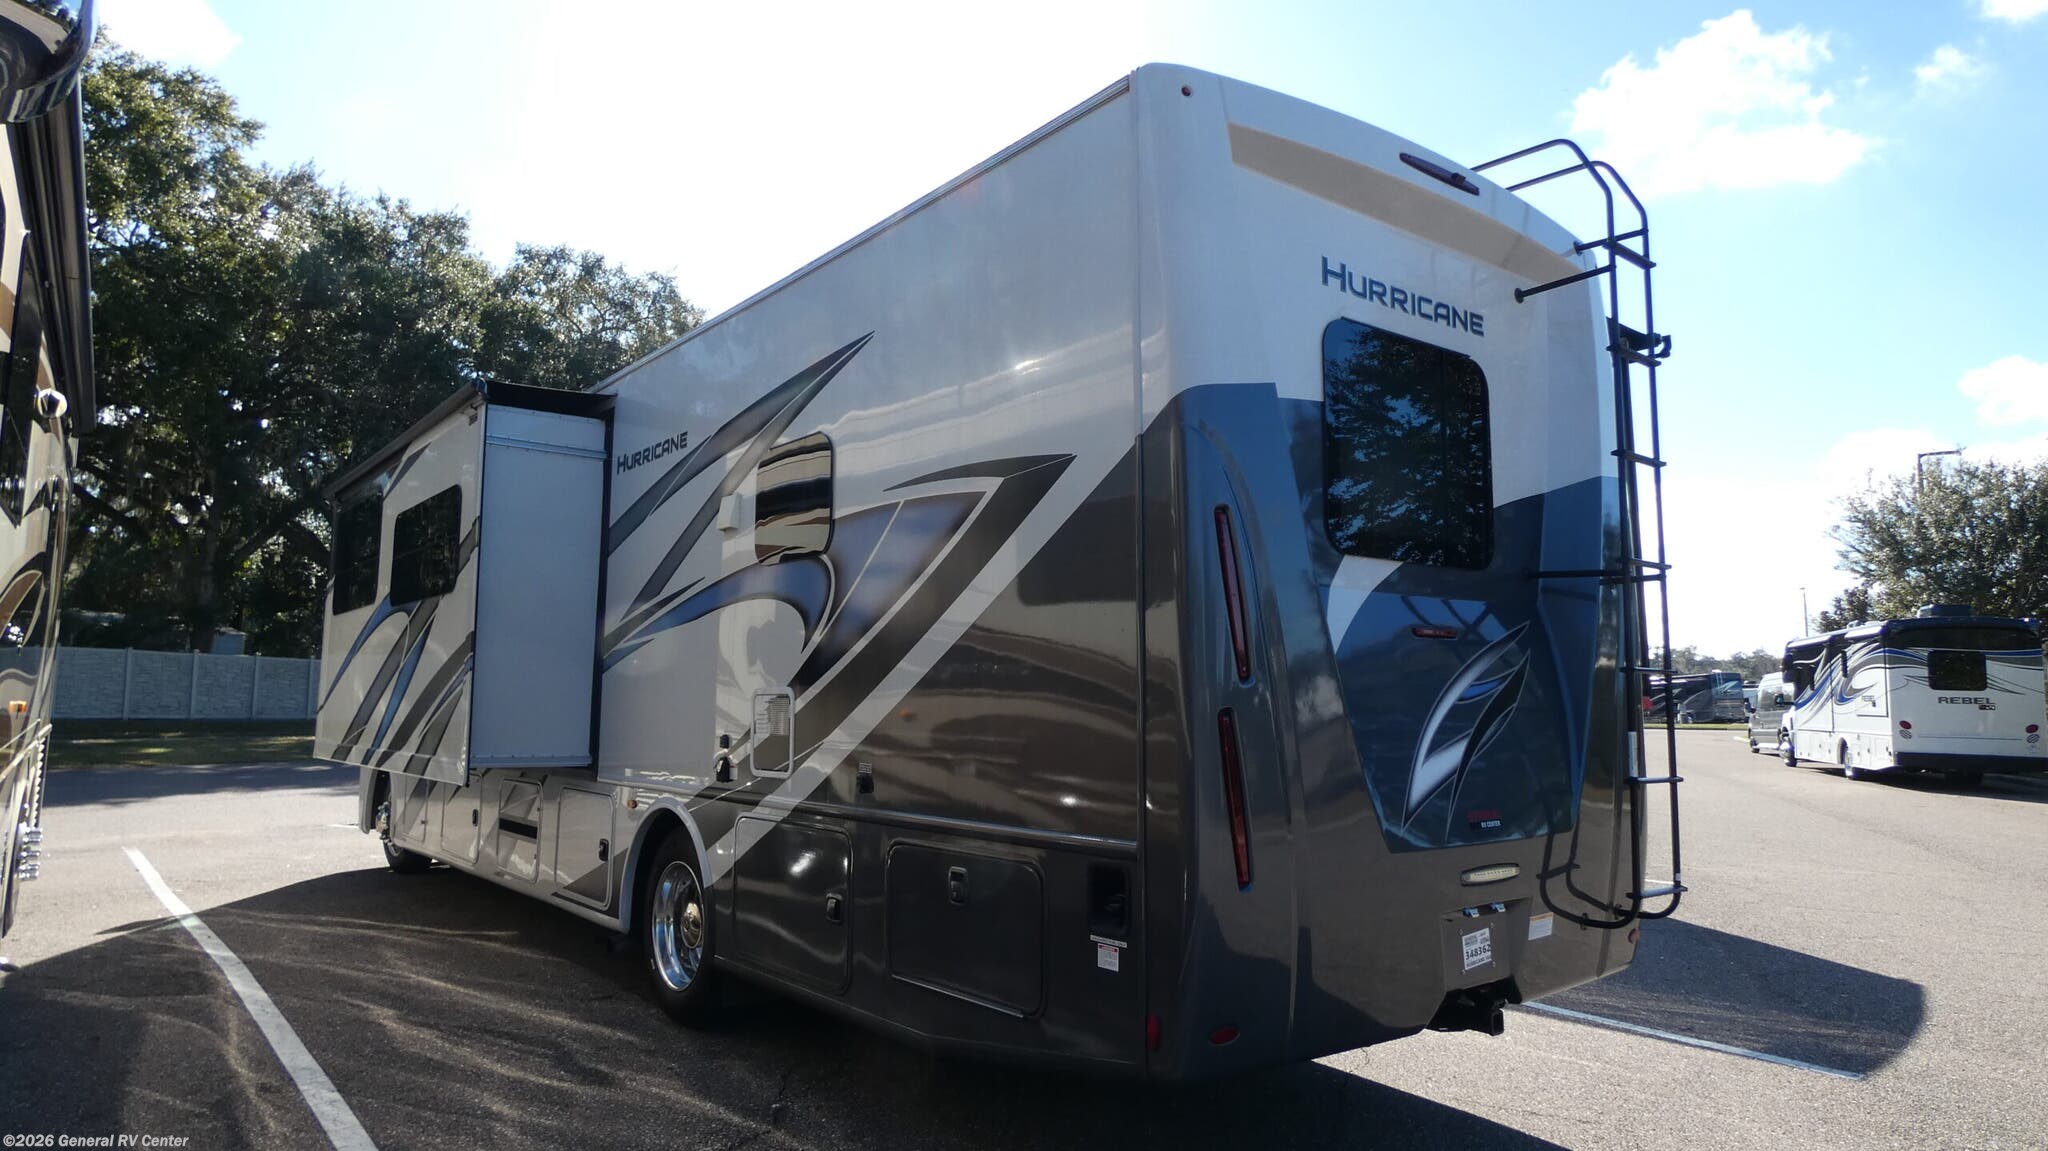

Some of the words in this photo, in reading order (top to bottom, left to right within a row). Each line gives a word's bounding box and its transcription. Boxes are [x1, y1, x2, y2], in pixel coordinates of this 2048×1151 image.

[1321, 255, 1485, 337] HURRICANE
[616, 431, 688, 475] HURRICANE
[1938, 696, 1996, 705] REBEL
